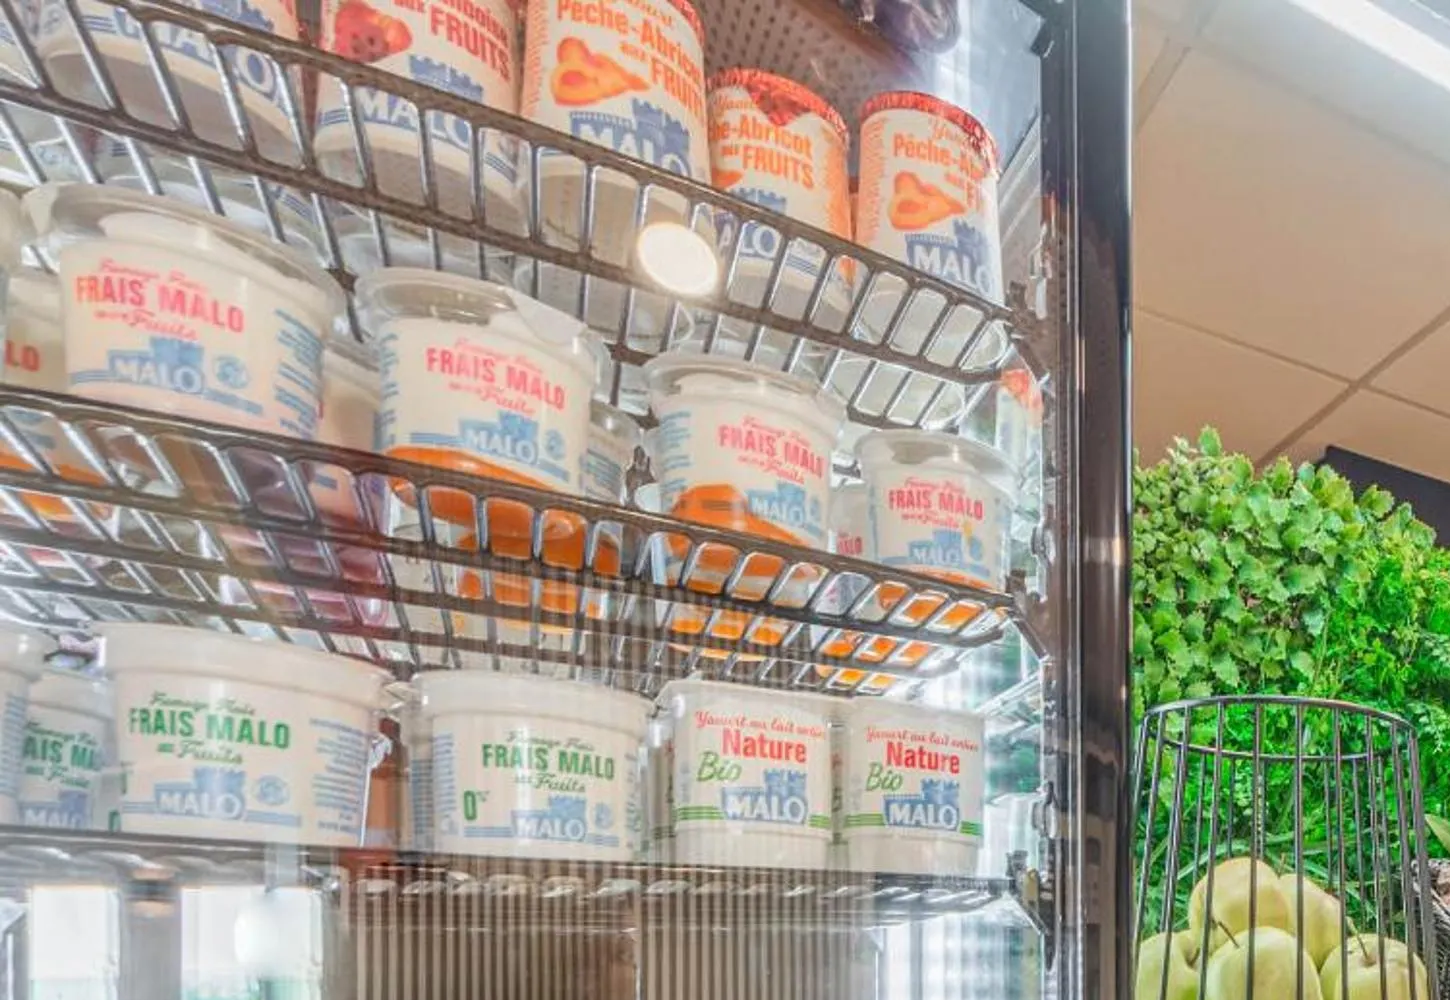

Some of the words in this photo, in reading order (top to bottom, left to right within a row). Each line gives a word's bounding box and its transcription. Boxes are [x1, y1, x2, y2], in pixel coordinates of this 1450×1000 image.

[430, 3, 511, 82] FRUITS
[651, 56, 704, 122] FRUIT
[742, 146, 814, 190] FRUITS
[912, 243, 995, 294] MALO
[76, 275, 145, 307] FRAIS
[157, 284, 245, 334] MALO
[5, 339, 41, 373] LO
[113, 356, 203, 393] MALO
[426, 347, 495, 383] FRAIS
[506, 365, 566, 411] MALO
[464, 428, 537, 465] MALO
[719, 424, 777, 458] FRAIS
[888, 488, 931, 511] FRAIS
[938, 492, 983, 521] MALO
[128, 707, 195, 738] FRAIS
[206, 714, 291, 750] MALO
[722, 728, 807, 764] Nature
[23, 734, 64, 764] AIS
[481, 743, 549, 773] FRAIS
[558, 750, 615, 781] MALO
[697, 750, 743, 782] Bio
[886, 740, 961, 775] Nature
[865, 761, 904, 792] Bio
[157, 791, 242, 821] MALO
[724, 794, 806, 823] MALO
[887, 802, 958, 830] MALO
[514, 816, 586, 840] MALO
